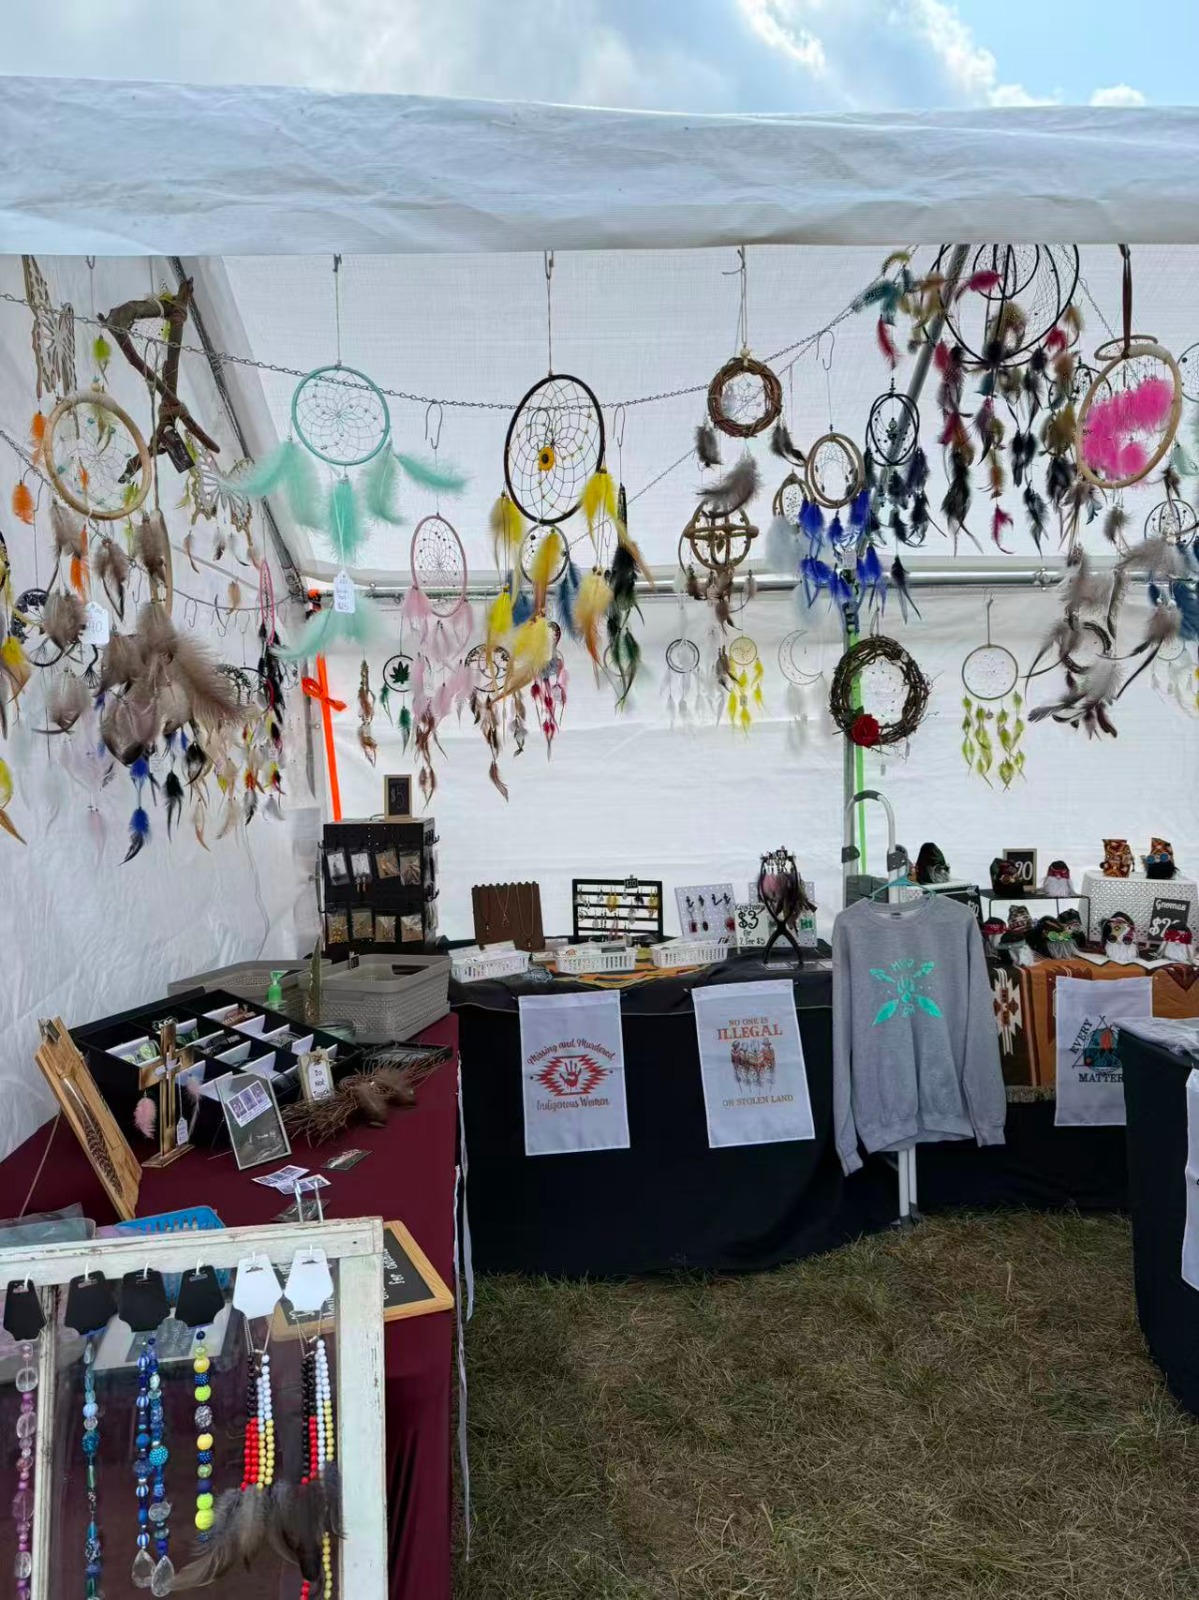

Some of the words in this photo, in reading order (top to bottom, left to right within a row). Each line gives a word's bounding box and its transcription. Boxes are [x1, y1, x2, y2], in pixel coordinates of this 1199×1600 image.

[738, 910, 759, 929] $3
[1149, 916, 1181, 938] $2
[729, 1019, 741, 1027] NO
[742, 1017, 760, 1025] ONE
[760, 1016, 769, 1024] IS
[717, 1024, 783, 1040] ILLEGAL
[1069, 1018, 1093, 1054] EVERY
[527, 1045, 558, 1065] Missing
[558, 1038, 576, 1050] and
[577, 1038, 616, 1060] Murdered
[537, 1100, 579, 1113] Indigenous
[579, 1096, 610, 1108] Women
[736, 1096, 769, 1106] STOLEN
[770, 1094, 794, 1103] LAND
